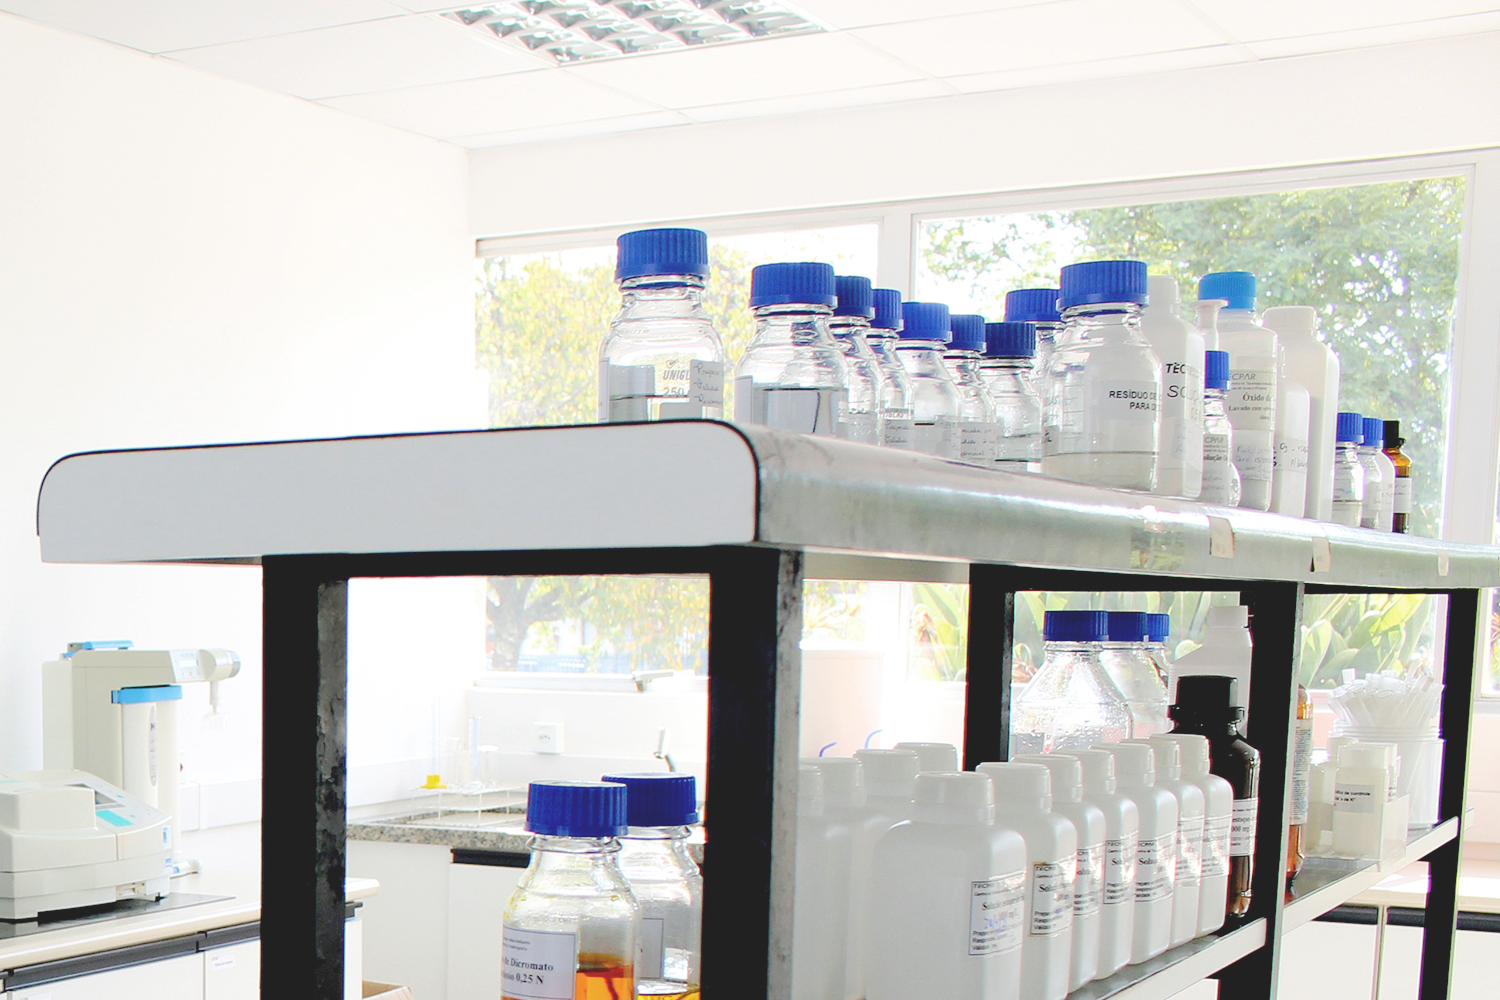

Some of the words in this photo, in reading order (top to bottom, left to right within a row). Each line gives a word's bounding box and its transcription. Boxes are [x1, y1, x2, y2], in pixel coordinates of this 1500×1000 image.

[662, 369, 690, 380] UNIGL
[1231, 373, 1256, 381] CPAR
[1109, 389, 1148, 399] RESÍDUO
[1130, 402, 1150, 410] PARA
[510, 957, 554, 972] Dicromato
[536, 975, 545, 984] N
